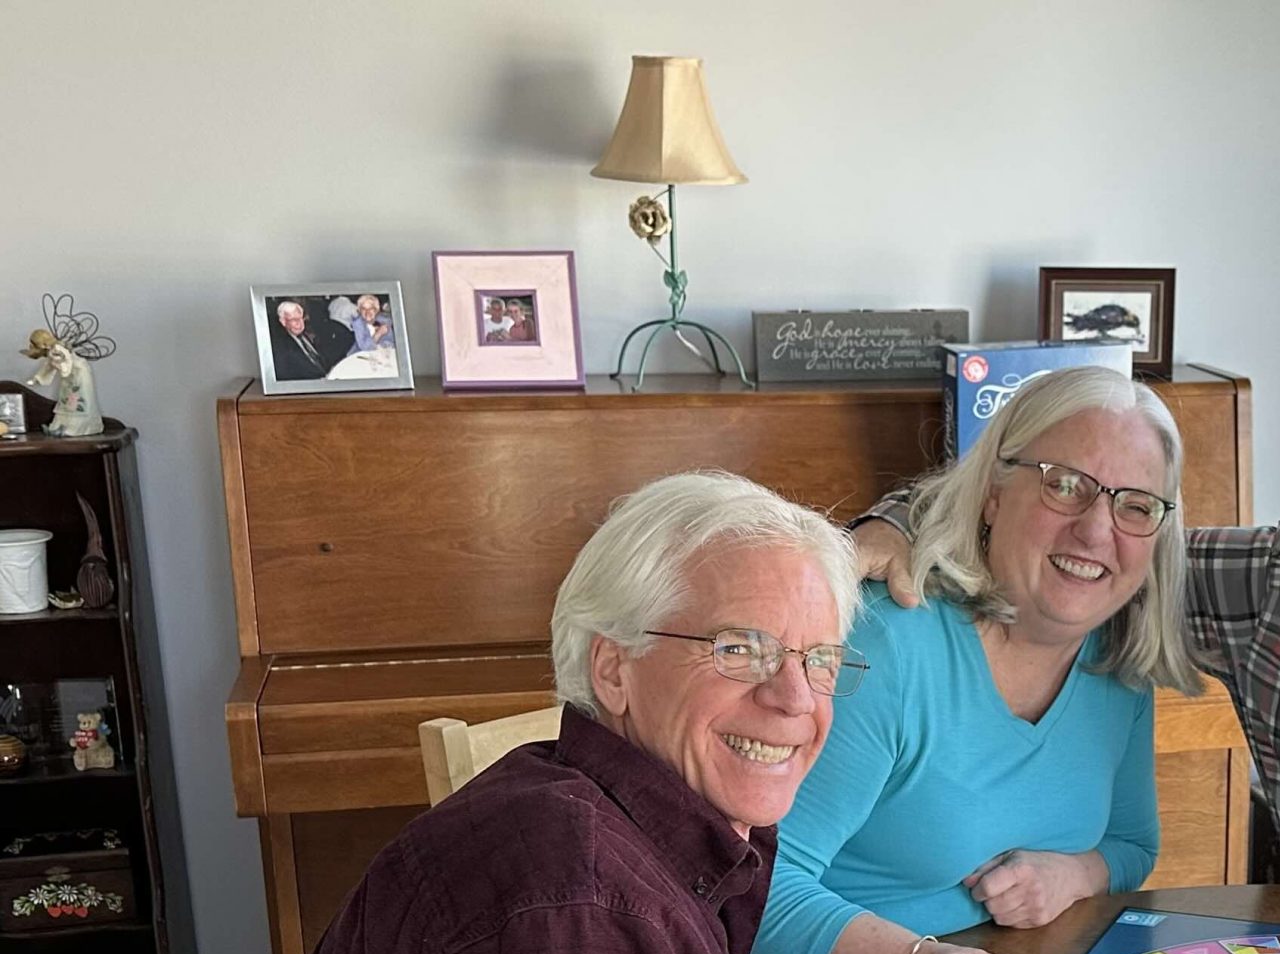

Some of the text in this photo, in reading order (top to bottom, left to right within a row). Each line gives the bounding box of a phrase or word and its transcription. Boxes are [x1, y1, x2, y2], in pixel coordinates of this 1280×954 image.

[772, 318, 813, 360] God
[821, 320, 862, 349] hope
[843, 337, 895, 359] mercy
[805, 348, 856, 370] grace
[853, 352, 891, 370] love
